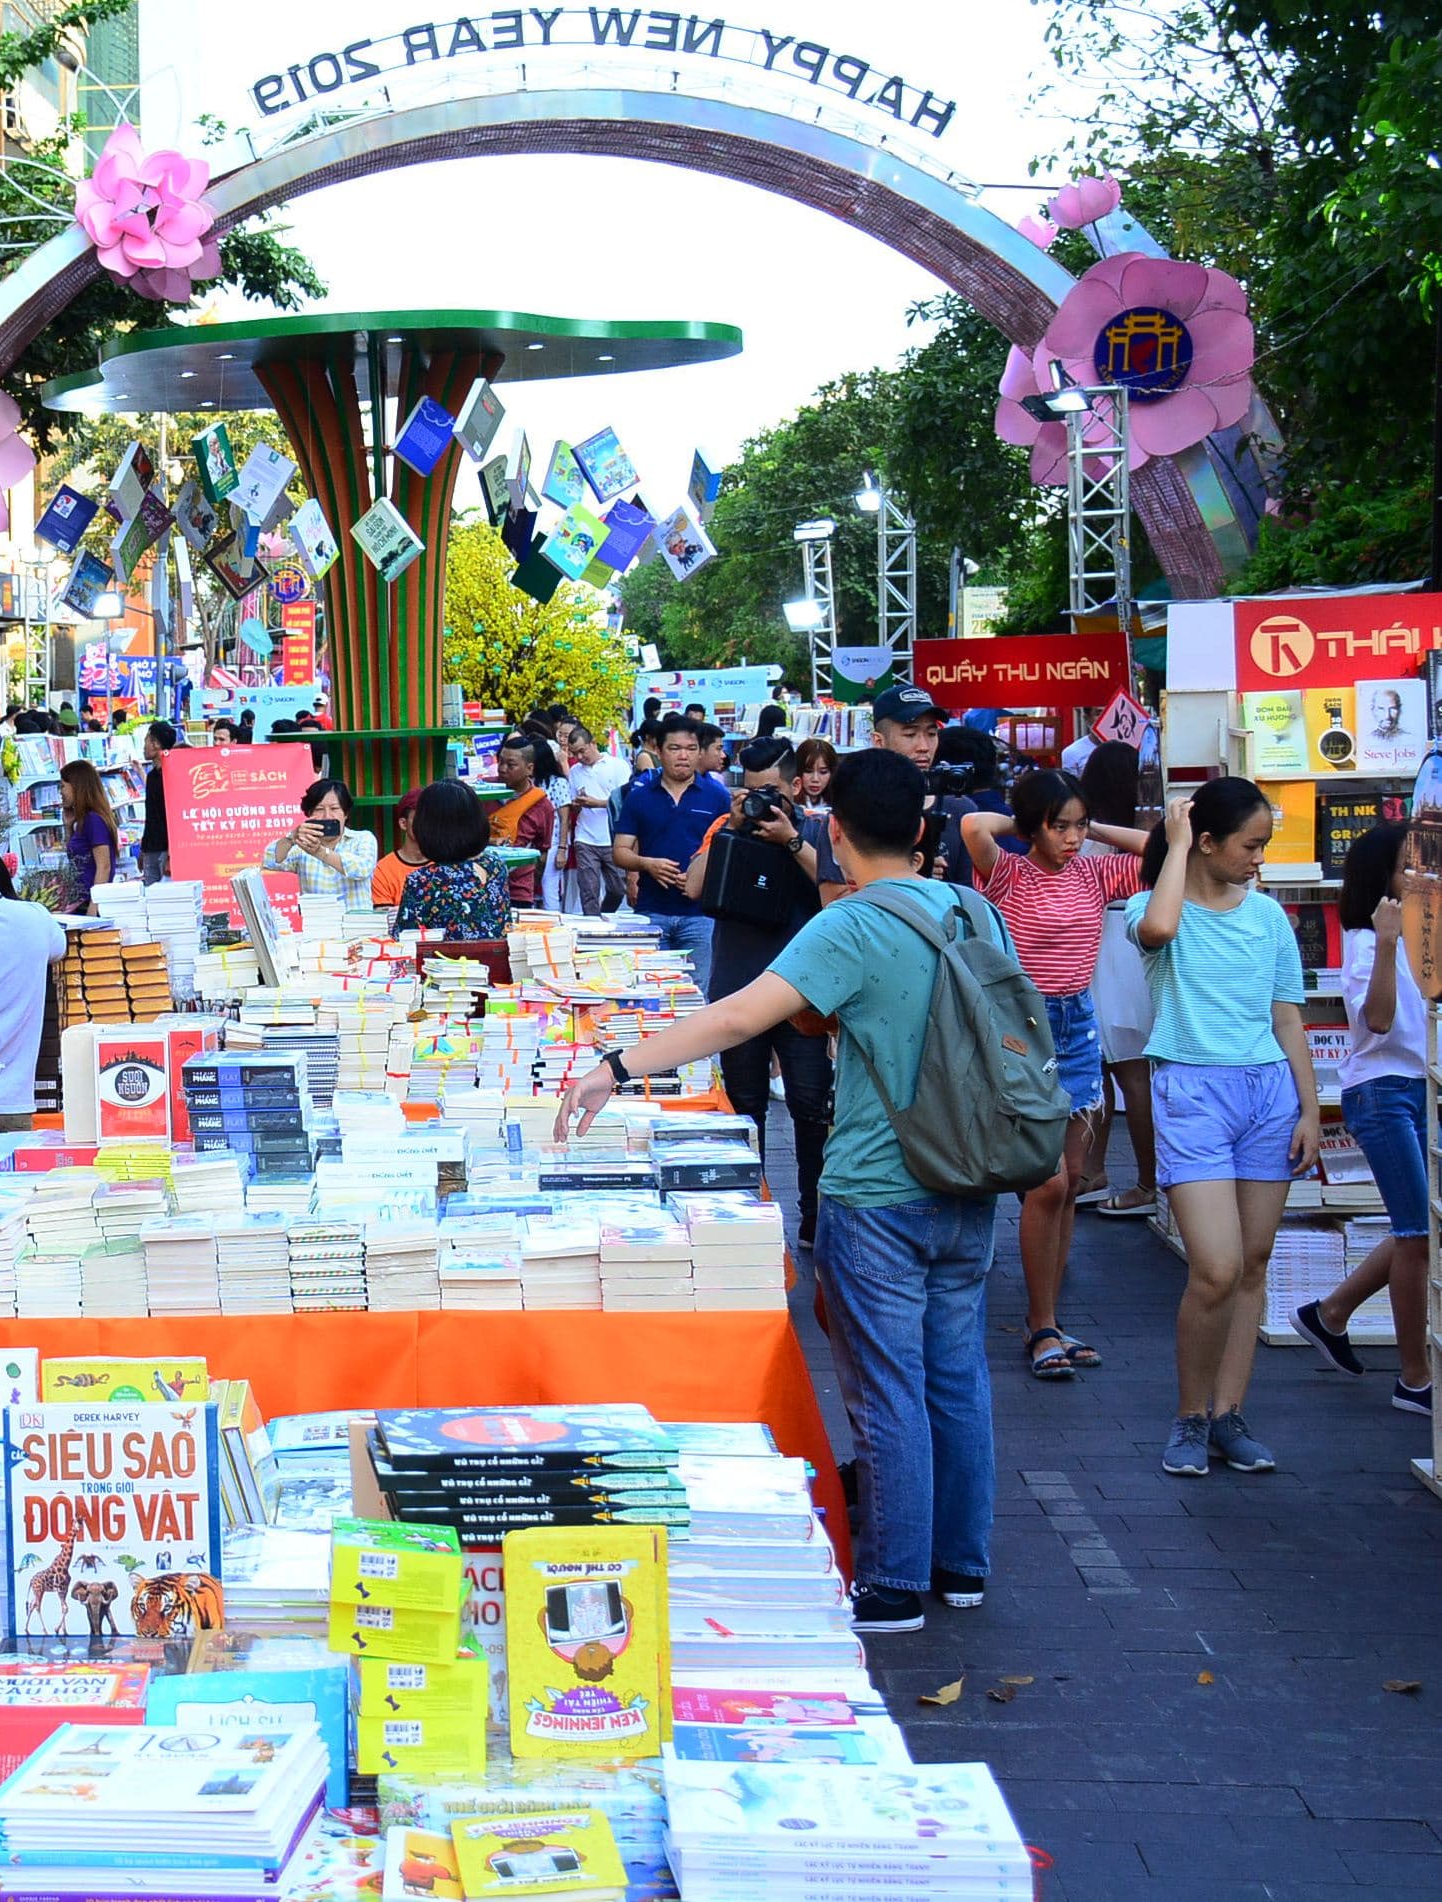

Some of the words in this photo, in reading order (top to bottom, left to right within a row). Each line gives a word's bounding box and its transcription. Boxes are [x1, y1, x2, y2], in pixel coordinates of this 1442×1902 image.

[1316, 618, 1420, 657] THÁI
[993, 663, 1039, 682] THU
[1046, 657, 1110, 681] NGÂN
[1363, 749, 1391, 760] Steve
[1393, 748, 1417, 764] Jobs
[250, 770, 287, 782] SÁCH
[266, 818, 294, 829] 2019
[74, 1413, 101, 1422] DEREK
[104, 1413, 140, 1422] HARVEY
[23, 1429, 113, 1481] SIÊU
[123, 1431, 196, 1479] SAO
[133, 1489, 200, 1543] VẬT
[533, 1713, 607, 1732] JENNINGS
[609, 1709, 640, 1729] KEN
